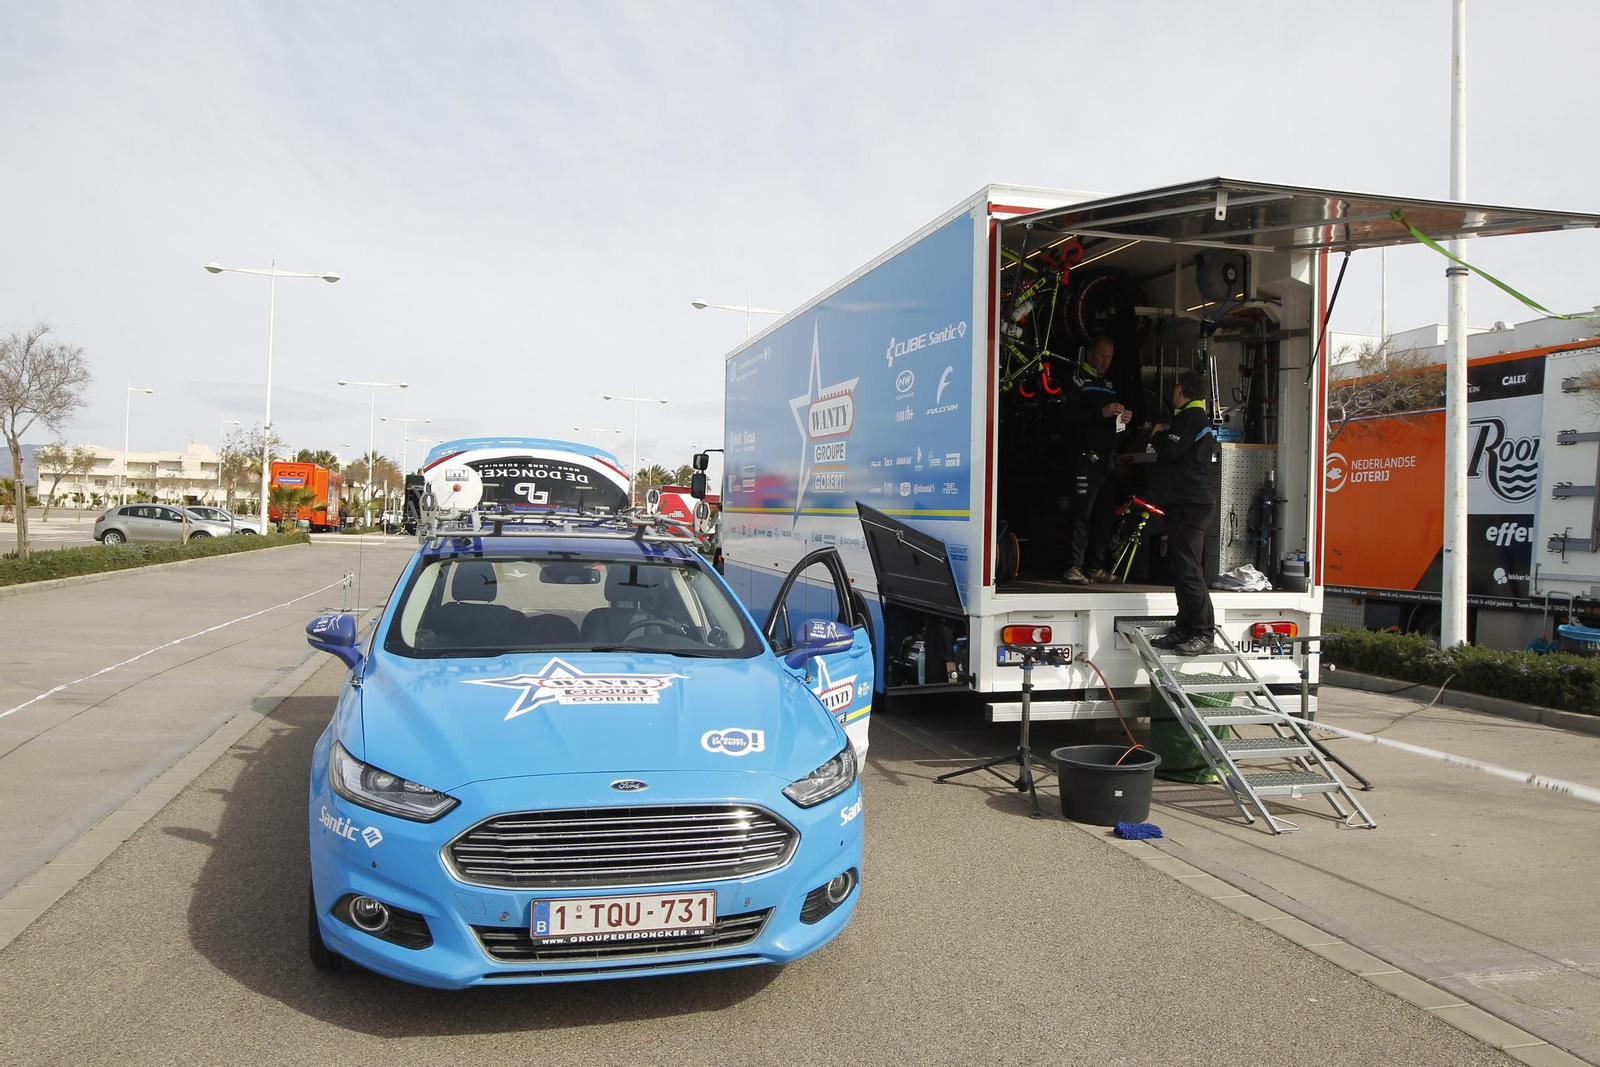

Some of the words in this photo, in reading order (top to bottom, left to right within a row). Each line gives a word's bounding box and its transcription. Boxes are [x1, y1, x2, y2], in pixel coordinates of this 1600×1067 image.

[1015, 277, 1046, 308] CUBE
[895, 333, 927, 357] CUBE
[928, 324, 957, 346] Santic
[1502, 374, 1526, 386] CALEX
[811, 404, 849, 431] WANTY
[815, 443, 844, 461] GROUPE
[1351, 456, 1416, 470] NEDERLANDSE
[565, 472, 589, 484] DE
[814, 474, 843, 490] GOBERT
[1350, 470, 1390, 483] LOTERIJ
[618, 781, 640, 789] Ford
[318, 805, 360, 841] Santic
[536, 921, 547, 933] B
[570, 930, 688, 943] GROUPEDEDONCKER
